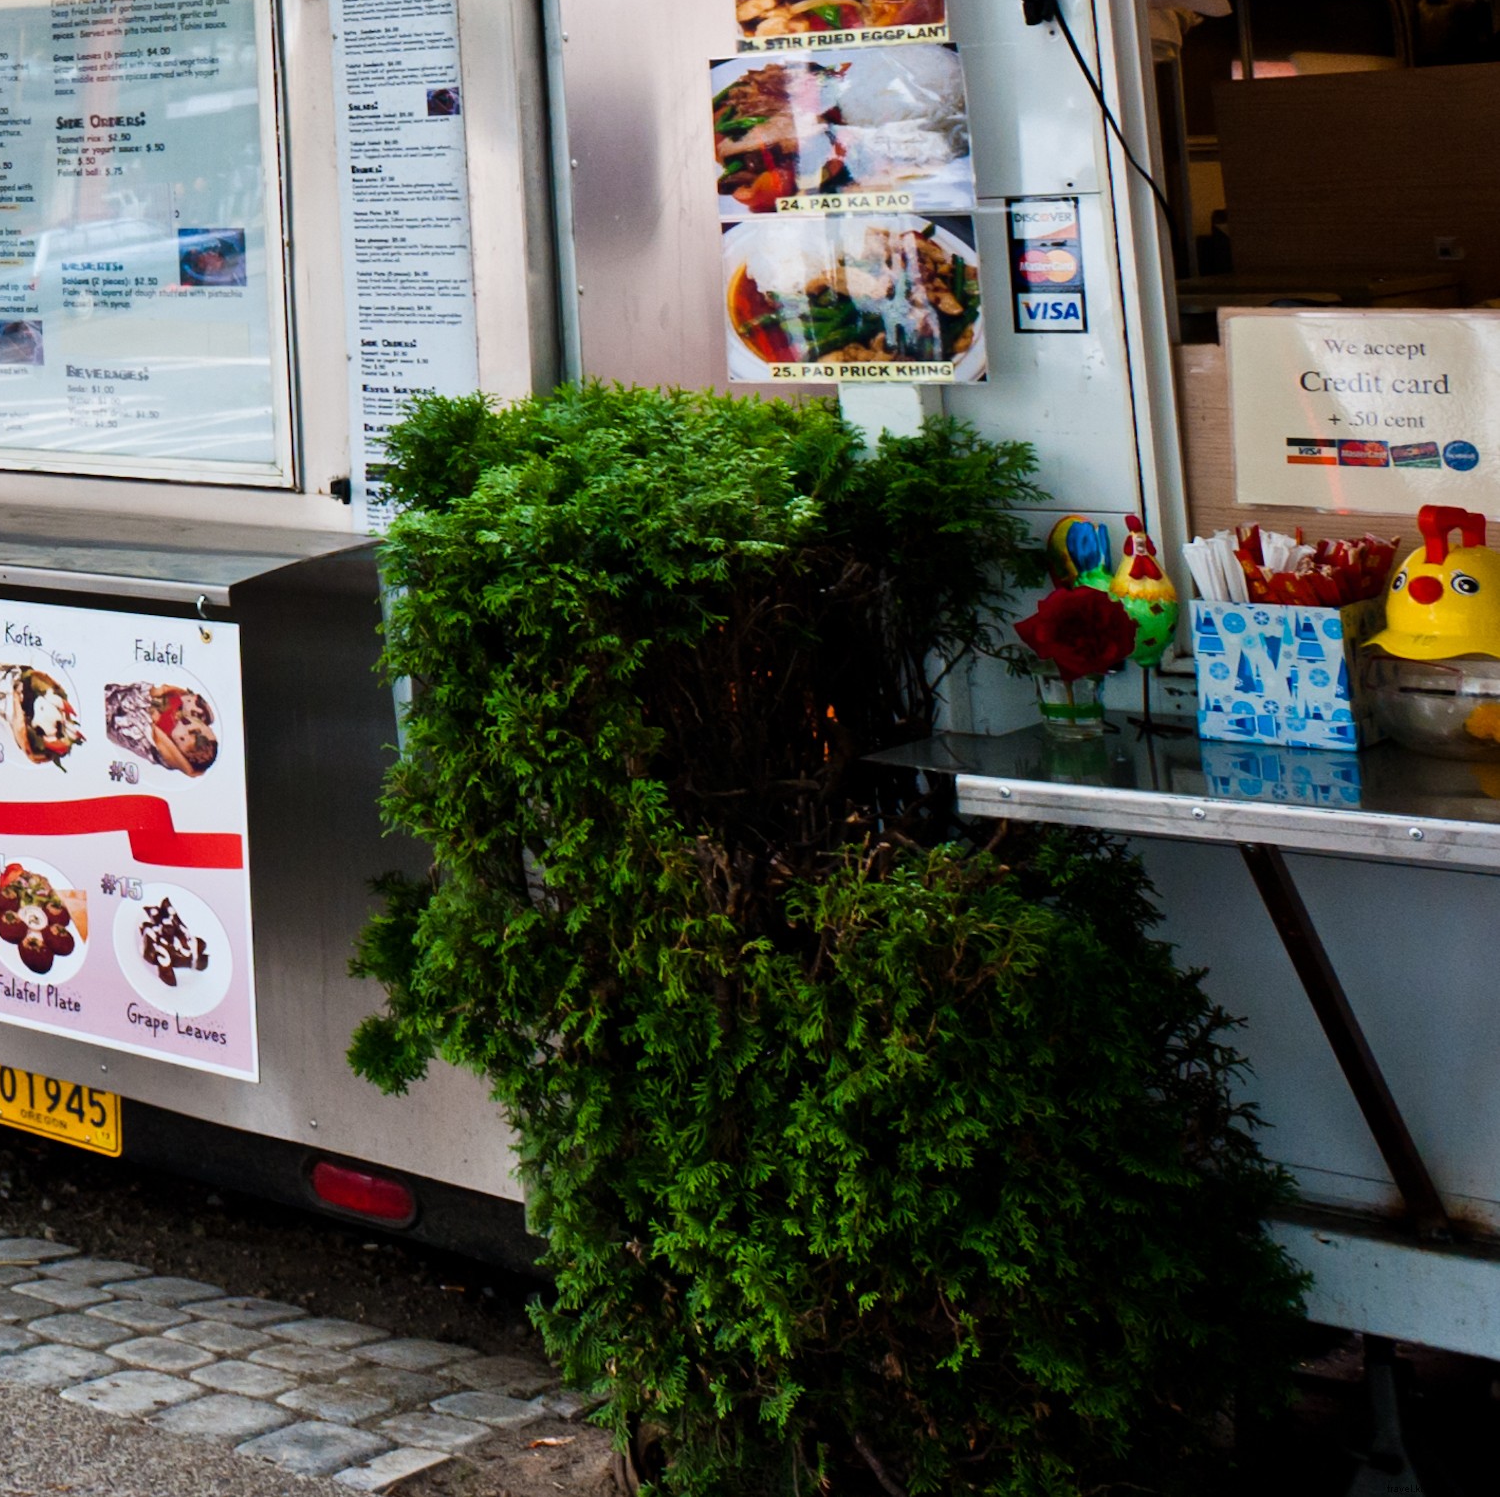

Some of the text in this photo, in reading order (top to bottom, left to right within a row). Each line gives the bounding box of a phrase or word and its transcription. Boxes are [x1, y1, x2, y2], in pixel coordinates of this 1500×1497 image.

[808, 32, 855, 47] FRIED
[861, 25, 947, 42] EGGPLANT
[780, 194, 909, 211] 24. PAD KA PAO
[1014, 211, 1072, 223] DISCOVER
[1023, 301, 1081, 321] VISA
[1324, 339, 1427, 360] We accept
[773, 364, 952, 377] 25. PAD PRICK KHING
[1300, 370, 1451, 394] Credit card
[1384, 414, 1425, 428] cent
[5, 622, 43, 648] Kofta
[135, 639, 184, 666] Falafel
[108, 760, 140, 785] #9
[100, 873, 143, 901] #15
[47, 984, 81, 1013] Plate
[126, 1003, 227, 1046] Grape Leaves
[0, 1063, 107, 1128] 01945
[20, 1108, 68, 1130] OREGON
